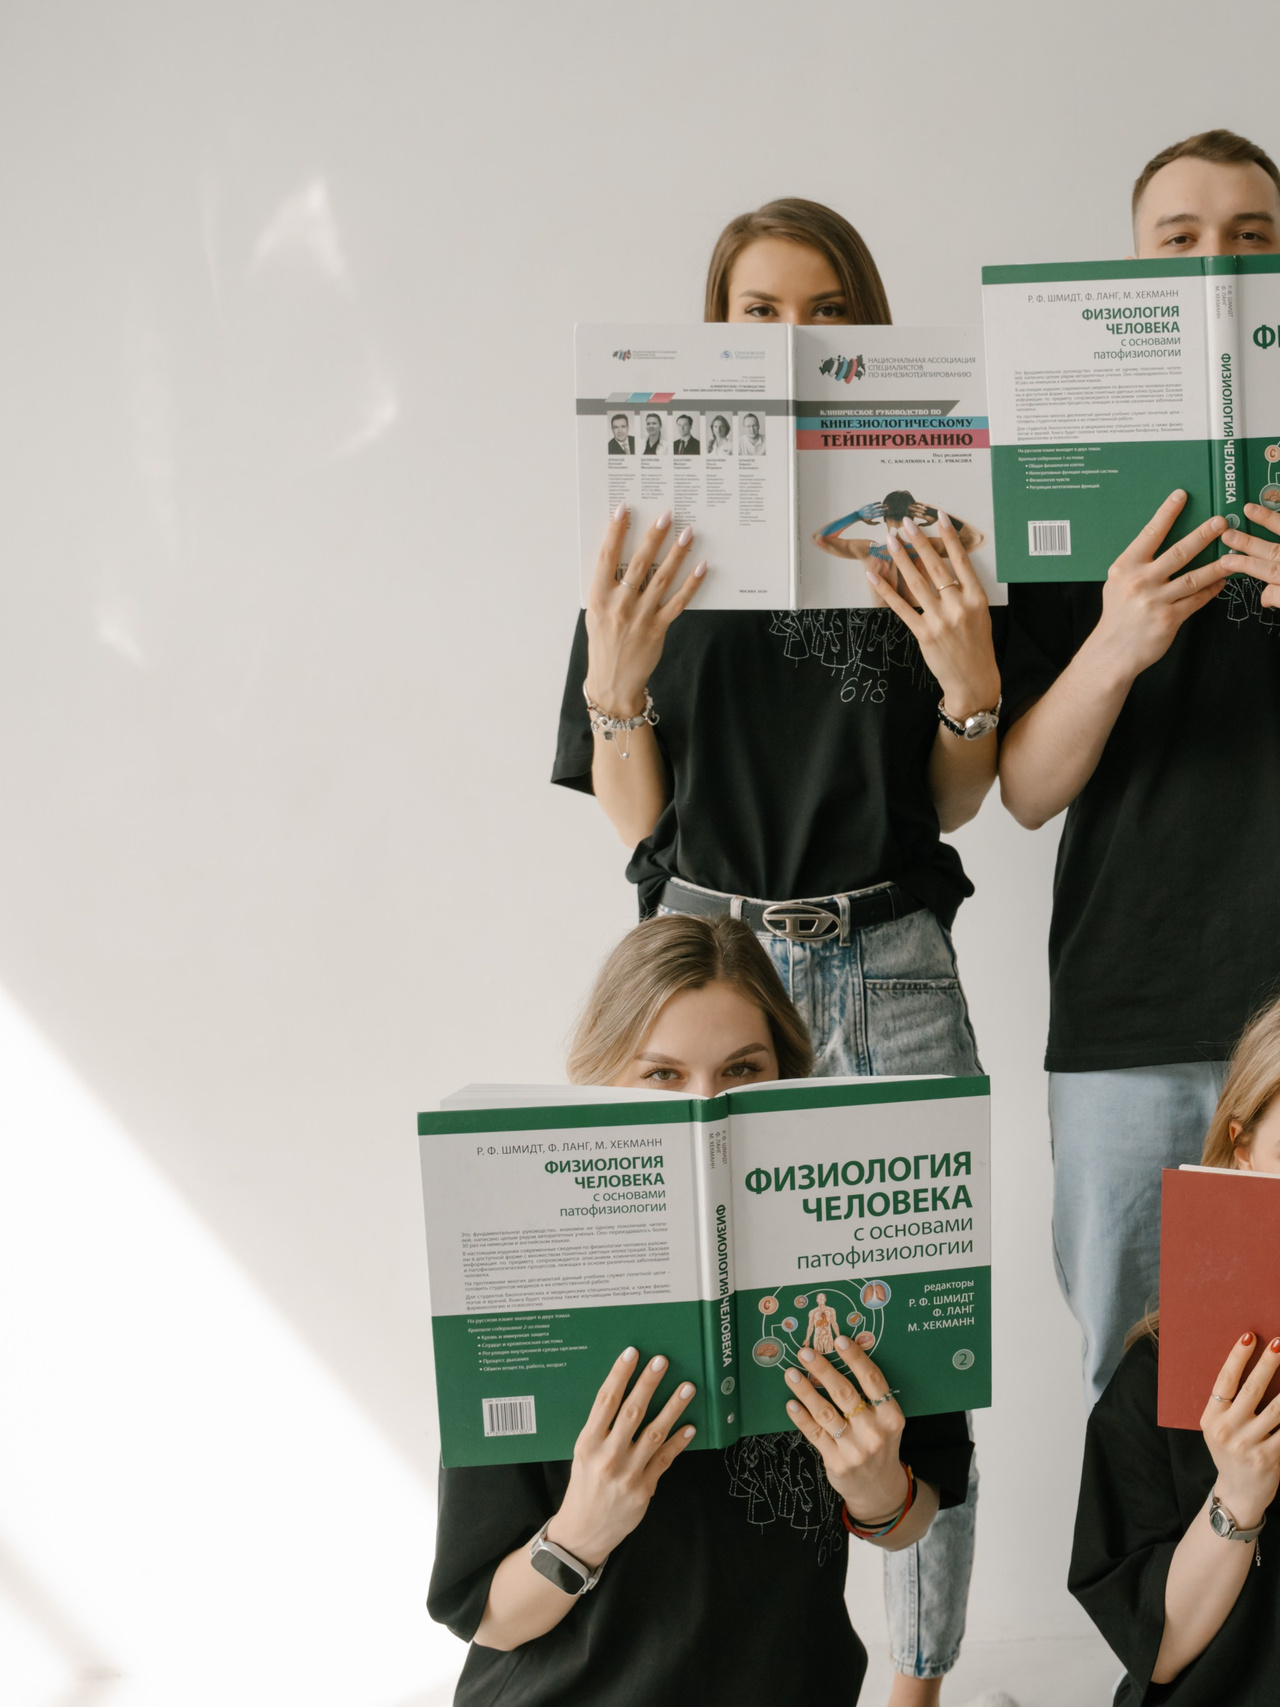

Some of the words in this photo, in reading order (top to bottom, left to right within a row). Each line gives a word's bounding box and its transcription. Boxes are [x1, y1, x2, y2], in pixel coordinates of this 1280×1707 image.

[1036, 295, 1046, 303] Ф.
[1048, 294, 1083, 303] ШМИДТ,
[1085, 293, 1095, 301] Ф.
[1097, 292, 1121, 301] ЛАНГ,
[1123, 291, 1134, 300] М.
[1136, 290, 1179, 299] ХЕКМАНН
[1082, 306, 1179, 321] ФИЗИОЛОГИЯ
[1106, 322, 1180, 335] ЧЕЛОВЕКА
[1129, 337, 1181, 346] основами
[1094, 349, 1181, 360] патофизиологии
[1221, 353, 1234, 438] ФИЗИОЛОГИЯ
[821, 418, 973, 428] КИНЕЗИОЛОГИЧЕСКОМУ
[821, 432, 973, 446] ТЕЙПИРОВАНИЮ
[1224, 440, 1236, 504] ЧЕЛОВЕКА
[840, 677, 888, 703] 618
[477, 1147, 485, 1156] Р.
[487, 1146, 499, 1155] Ф.
[501, 1144, 545, 1155] ШМИДТ,
[548, 1143, 560, 1153] Ф.
[562, 1142, 592, 1152] ЛАНГ,
[595, 1141, 608, 1150] М.
[610, 1138, 662, 1149] ХЕКМАНН
[544, 1155, 664, 1174] ФИЗИОЛОГИЯ
[745, 1151, 972, 1194] ФИЗИОЛОГИЯ
[574, 1172, 665, 1189] ЧЕЛОВЕКА
[593, 1193, 600, 1202] с
[603, 1190, 666, 1202] основами
[802, 1184, 973, 1222] ЧЕЛОВЕКА
[560, 1202, 667, 1218] патофизиологии
[854, 1228, 865, 1241] с
[870, 1217, 973, 1240] основами
[715, 1204, 729, 1296] ФИЗИОЛОГИЯ
[798, 1240, 973, 1269] патофизиологии
[924, 1280, 974, 1293] редакторы
[909, 1299, 917, 1308] Р.
[918, 1296, 931, 1306] Ф.
[933, 1292, 974, 1306] ШМИДТ
[932, 1308, 944, 1318] Ф.
[946, 1305, 974, 1316] ЛАНГ
[720, 1297, 733, 1368] ЧЕЛОВЕКА
[908, 1322, 921, 1332] М.
[923, 1317, 975, 1330] ХЕКМАНН
[959, 1353, 968, 1366] 2
